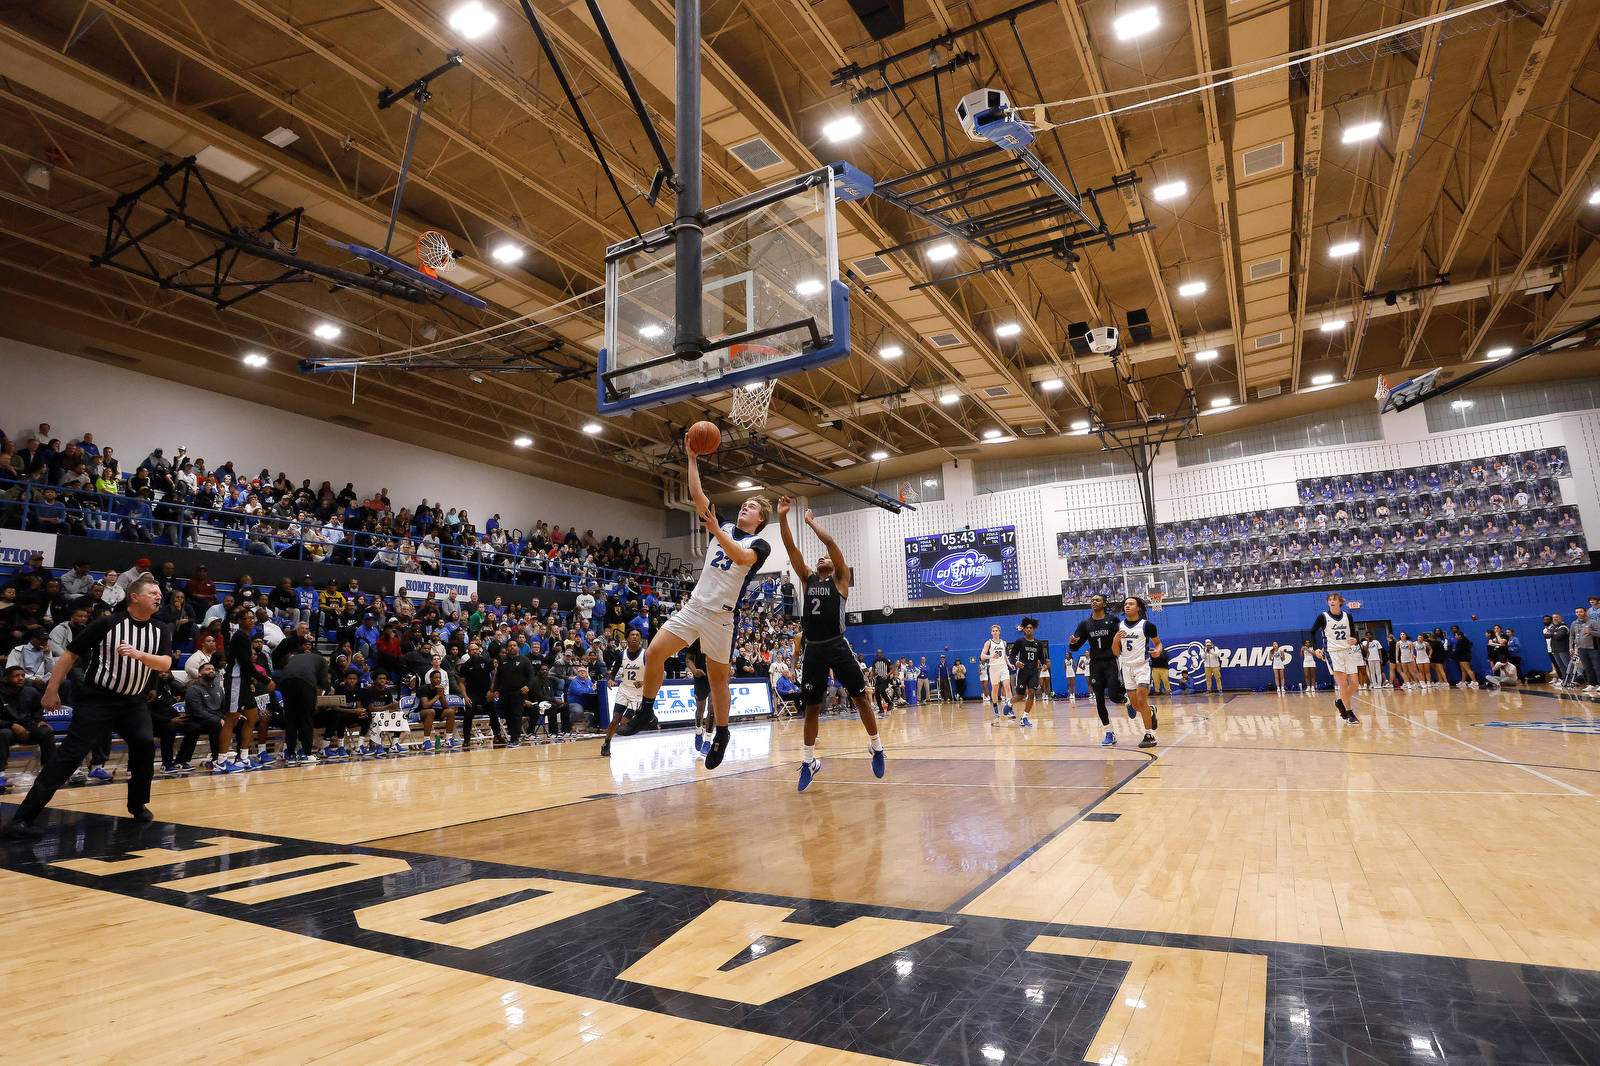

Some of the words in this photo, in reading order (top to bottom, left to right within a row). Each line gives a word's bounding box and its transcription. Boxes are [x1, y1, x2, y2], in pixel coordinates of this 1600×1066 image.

[941, 531, 976, 545] 05:43
[1001, 531, 1014, 543] 17
[906, 543, 918, 553] 13
[711, 550, 733, 571] 23
[937, 569, 950, 578] GO
[405, 580, 431, 592] HOME
[432, 583, 469, 596] SECTION
[811, 598, 821, 614] 2
[1089, 629, 1109, 638] VASHON
[1334, 631, 1346, 640] 22
[1097, 638, 1102, 649] 1
[1127, 640, 1133, 651] 5
[1027, 652, 1035, 661] 13
[1219, 645, 1294, 668] RAMS
[628, 671, 636, 680] 12
[48, 836, 1267, 1066] LADUE
